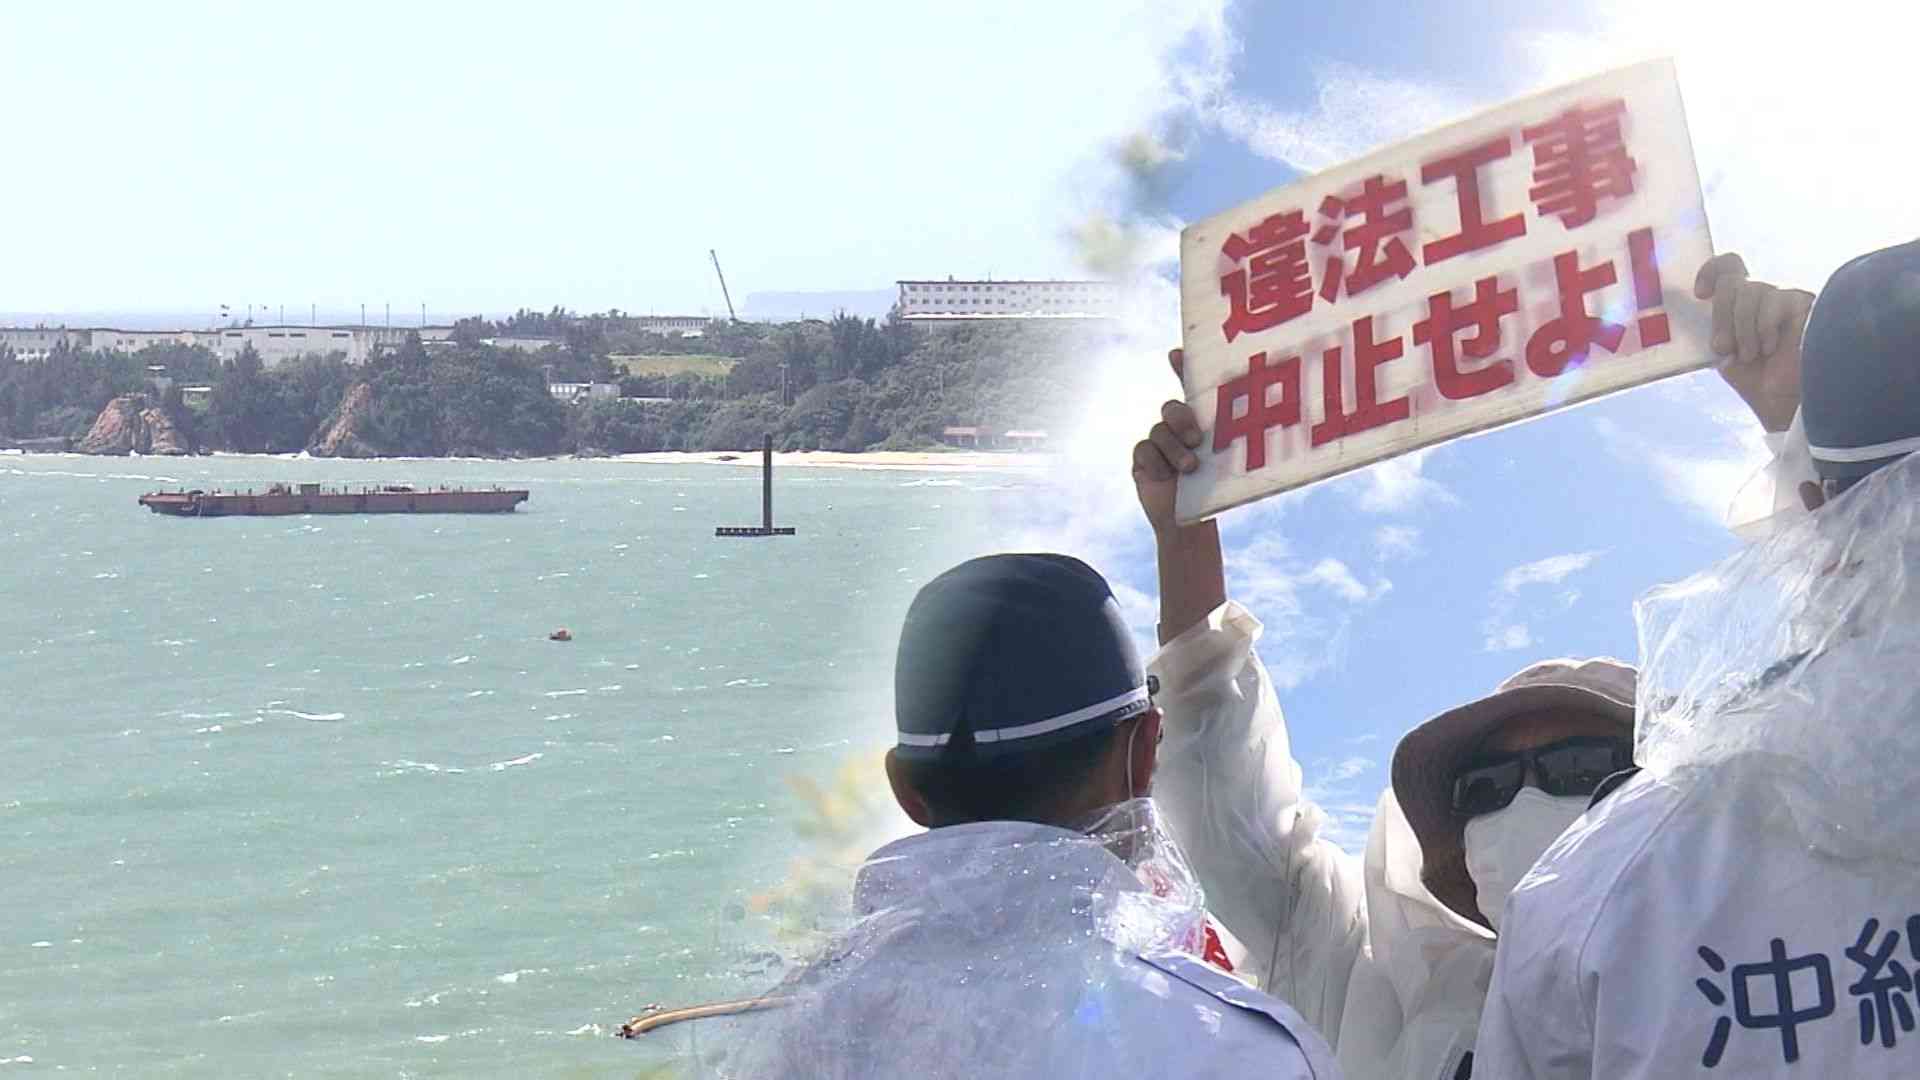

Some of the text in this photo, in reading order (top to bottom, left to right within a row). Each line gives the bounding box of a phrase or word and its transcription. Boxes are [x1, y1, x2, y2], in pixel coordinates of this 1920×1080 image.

[1219, 99, 1640, 342] 違法工事
[1213, 228, 1671, 472] 中止せよ!
